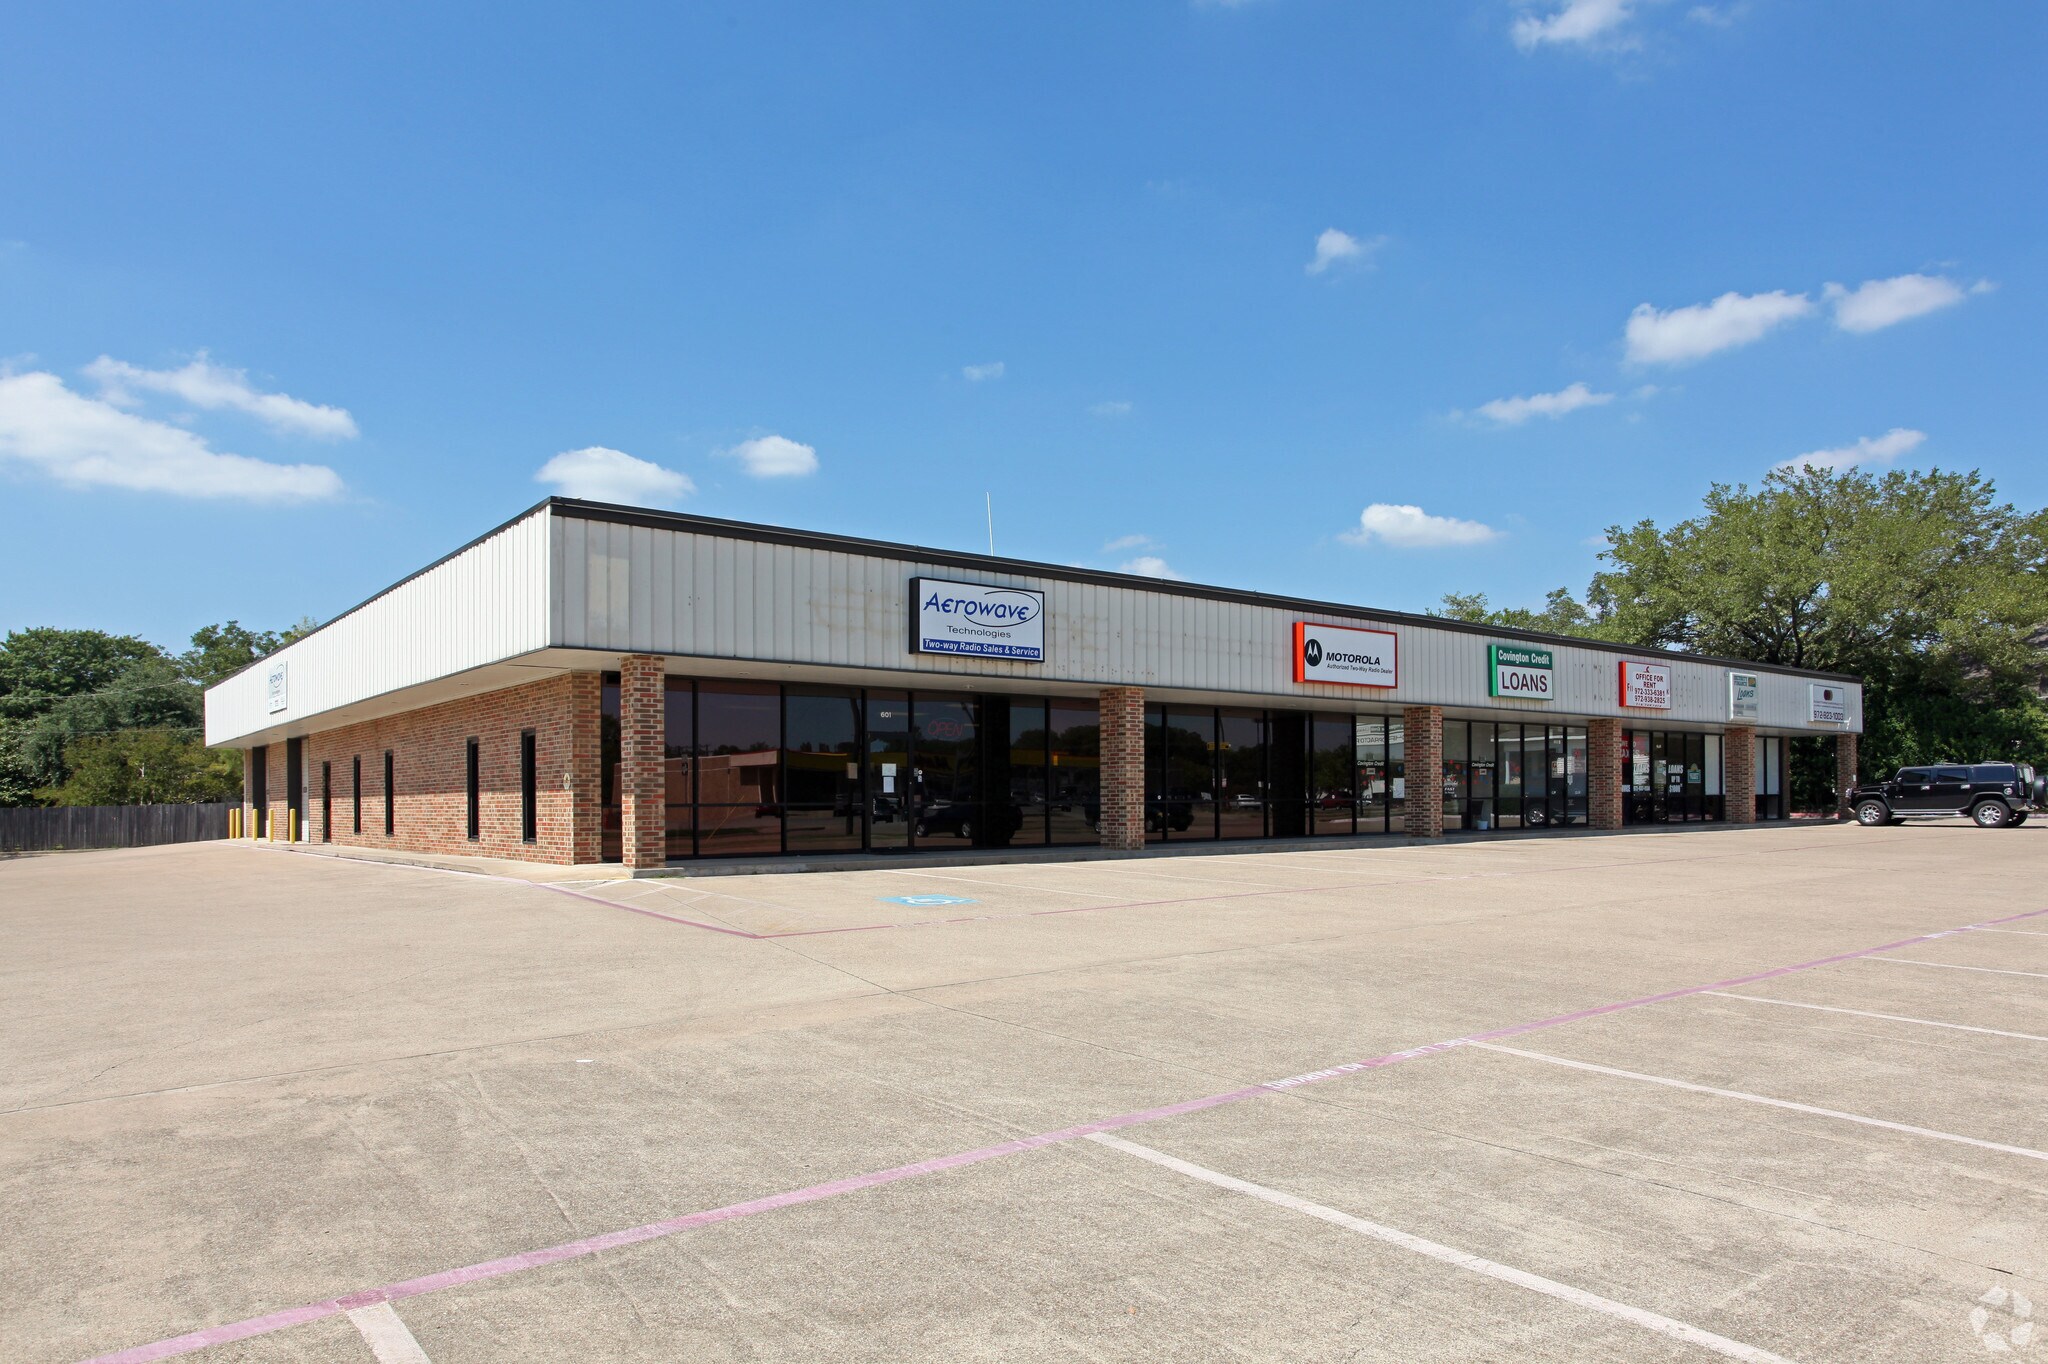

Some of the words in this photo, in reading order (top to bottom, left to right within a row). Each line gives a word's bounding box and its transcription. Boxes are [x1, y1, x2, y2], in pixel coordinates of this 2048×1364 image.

[946, 625, 1012, 639] Technologies
[925, 640, 959, 652] Two-way
[959, 642, 982, 652] Radio
[982, 644, 1003, 654] Sales
[1004, 645, 1010, 654] &
[1011, 646, 1039, 656] Service
[1326, 652, 1380, 665] MOTOROLA
[1498, 649, 1530, 664] Covington
[1530, 652, 1550, 665] Credit
[1350, 665, 1368, 673] Two-Way
[1501, 671, 1548, 693] LOANS
[1635, 673, 1653, 681] OFFICE
[1643, 681, 1656, 689] RENT
[927, 720, 965, 737] OPEN
